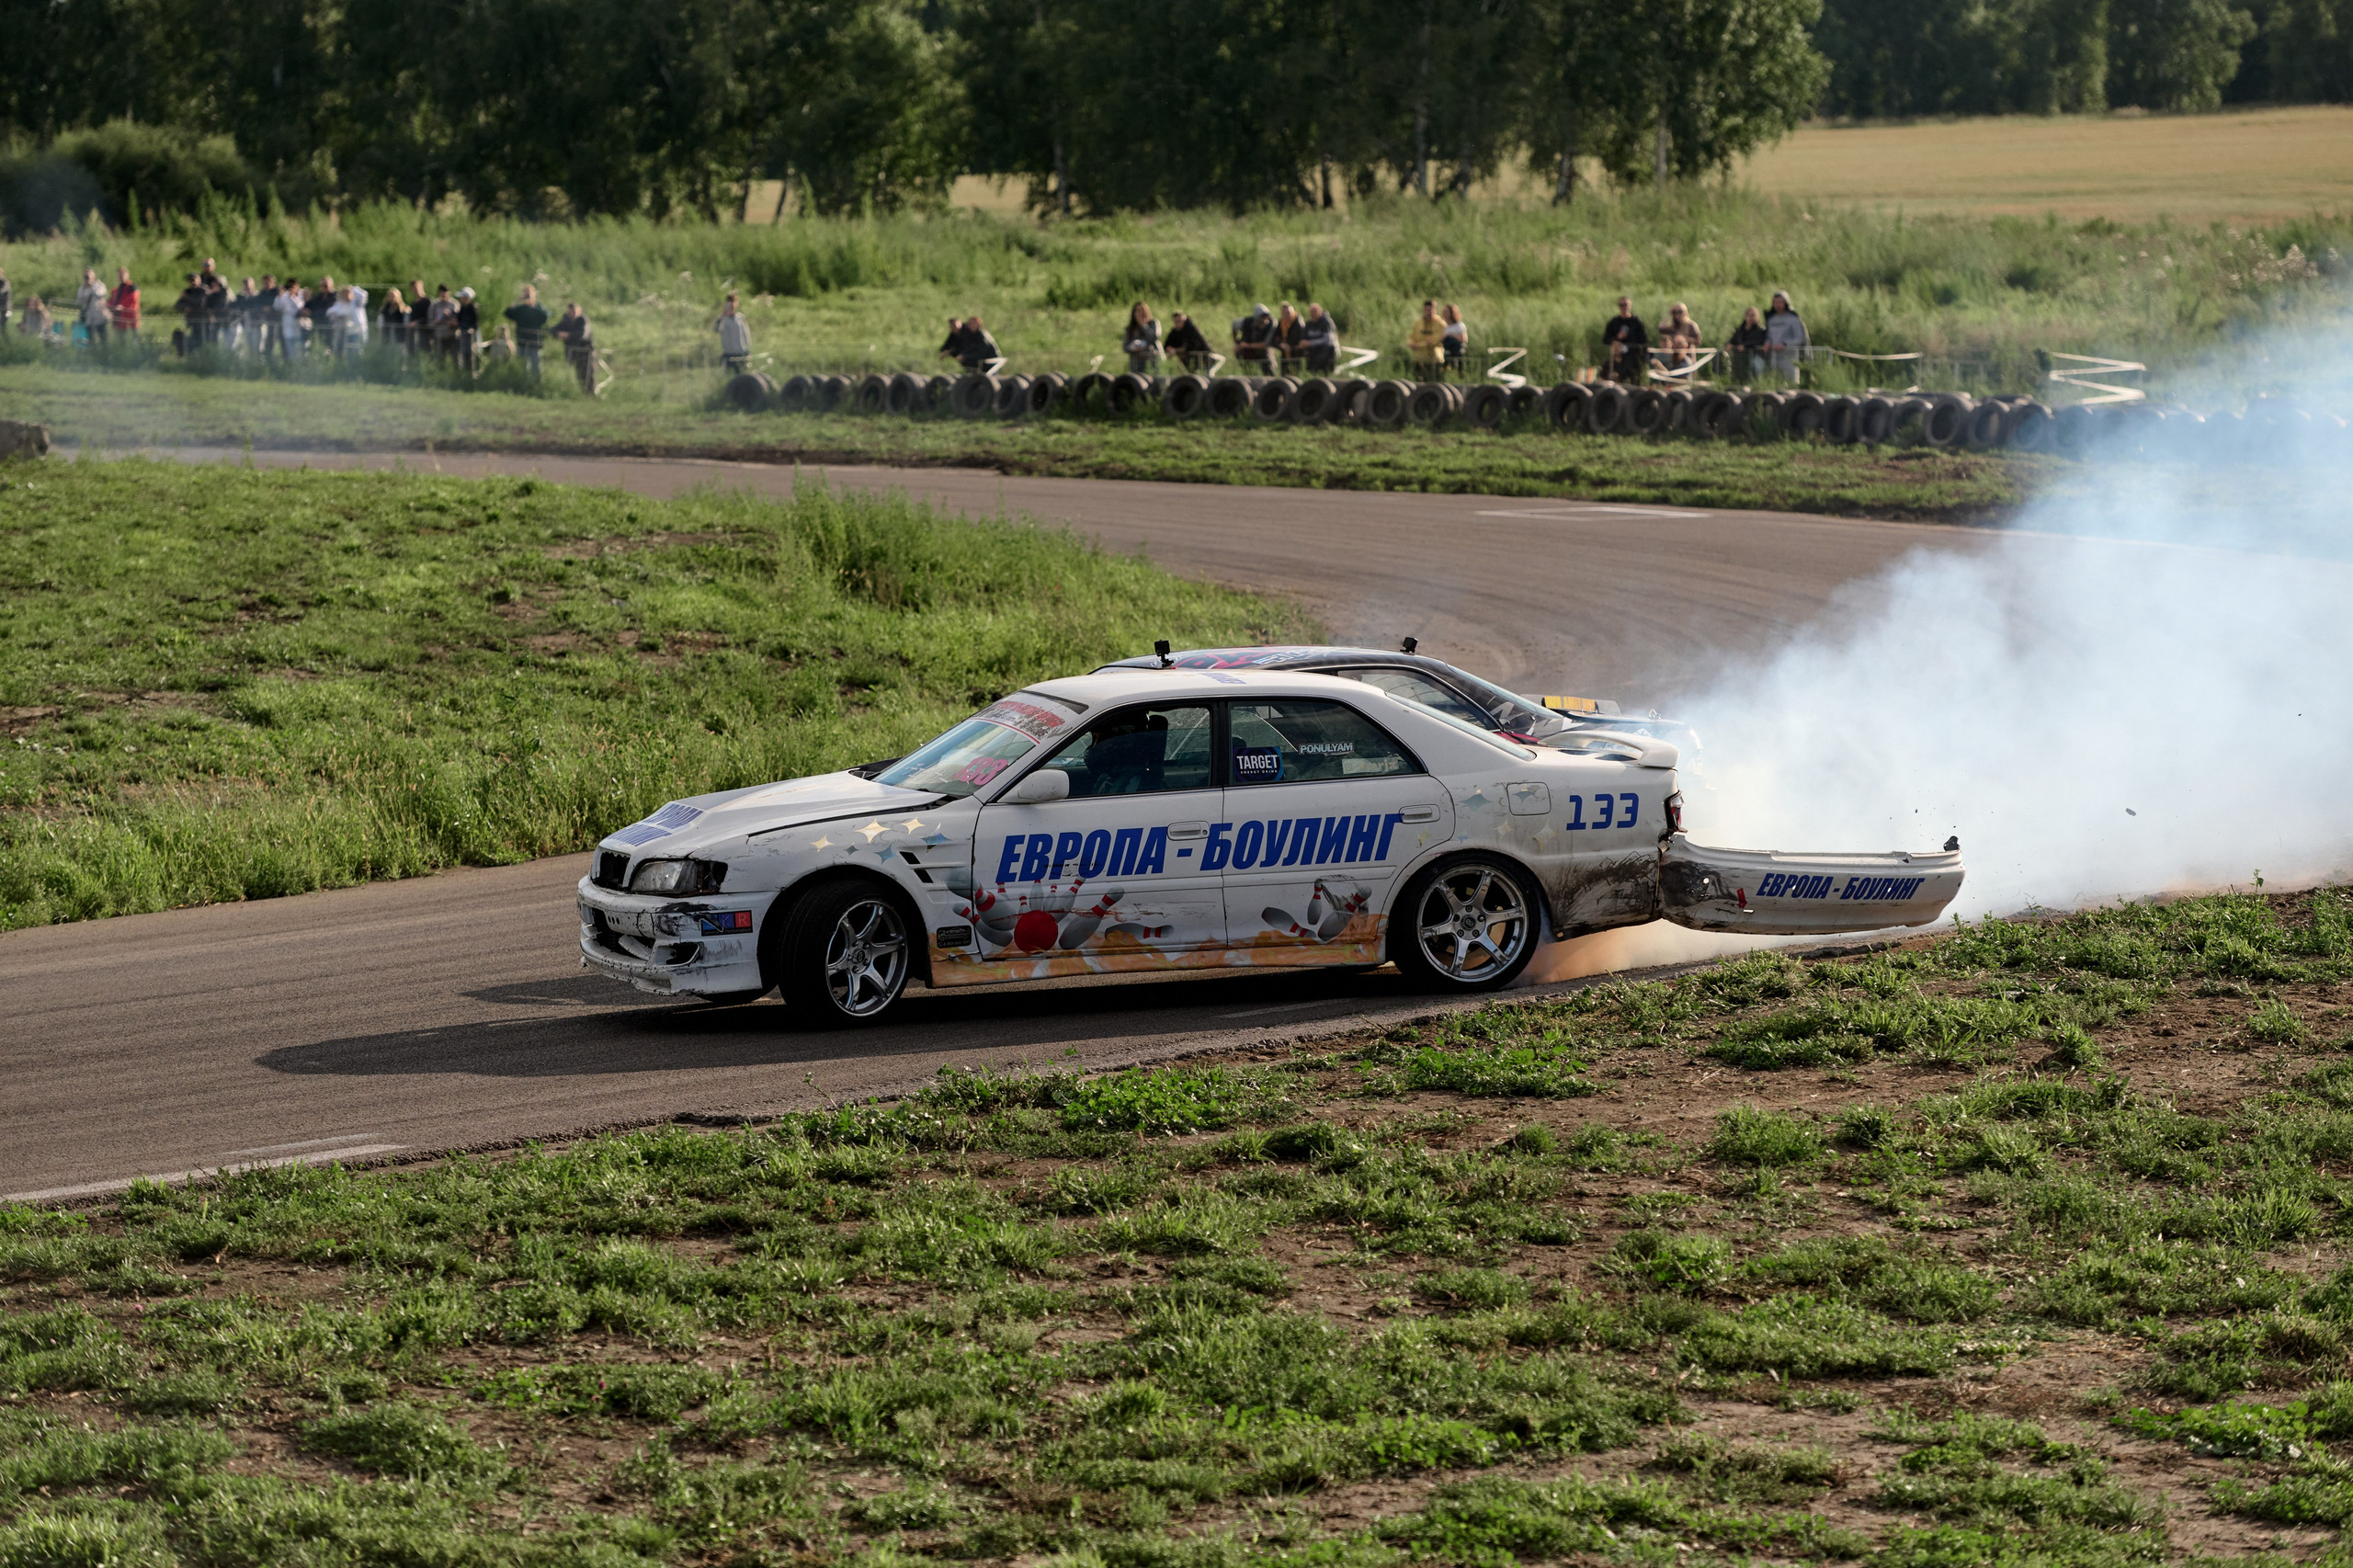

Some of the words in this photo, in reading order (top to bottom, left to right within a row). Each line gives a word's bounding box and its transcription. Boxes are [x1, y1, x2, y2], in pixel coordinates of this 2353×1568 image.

[1236, 755, 1278, 769] TARGET
[1300, 742, 1353, 754] PONULYAM
[952, 756, 1009, 786] 133
[1565, 792, 1639, 831] 133
[995, 826, 1169, 884] ЕВРОПА
[1199, 812, 1405, 871] БОУЛИНГ
[1756, 873, 1835, 899] ЕВРОПА
[1839, 877, 1926, 900] БОУЛИНГ
